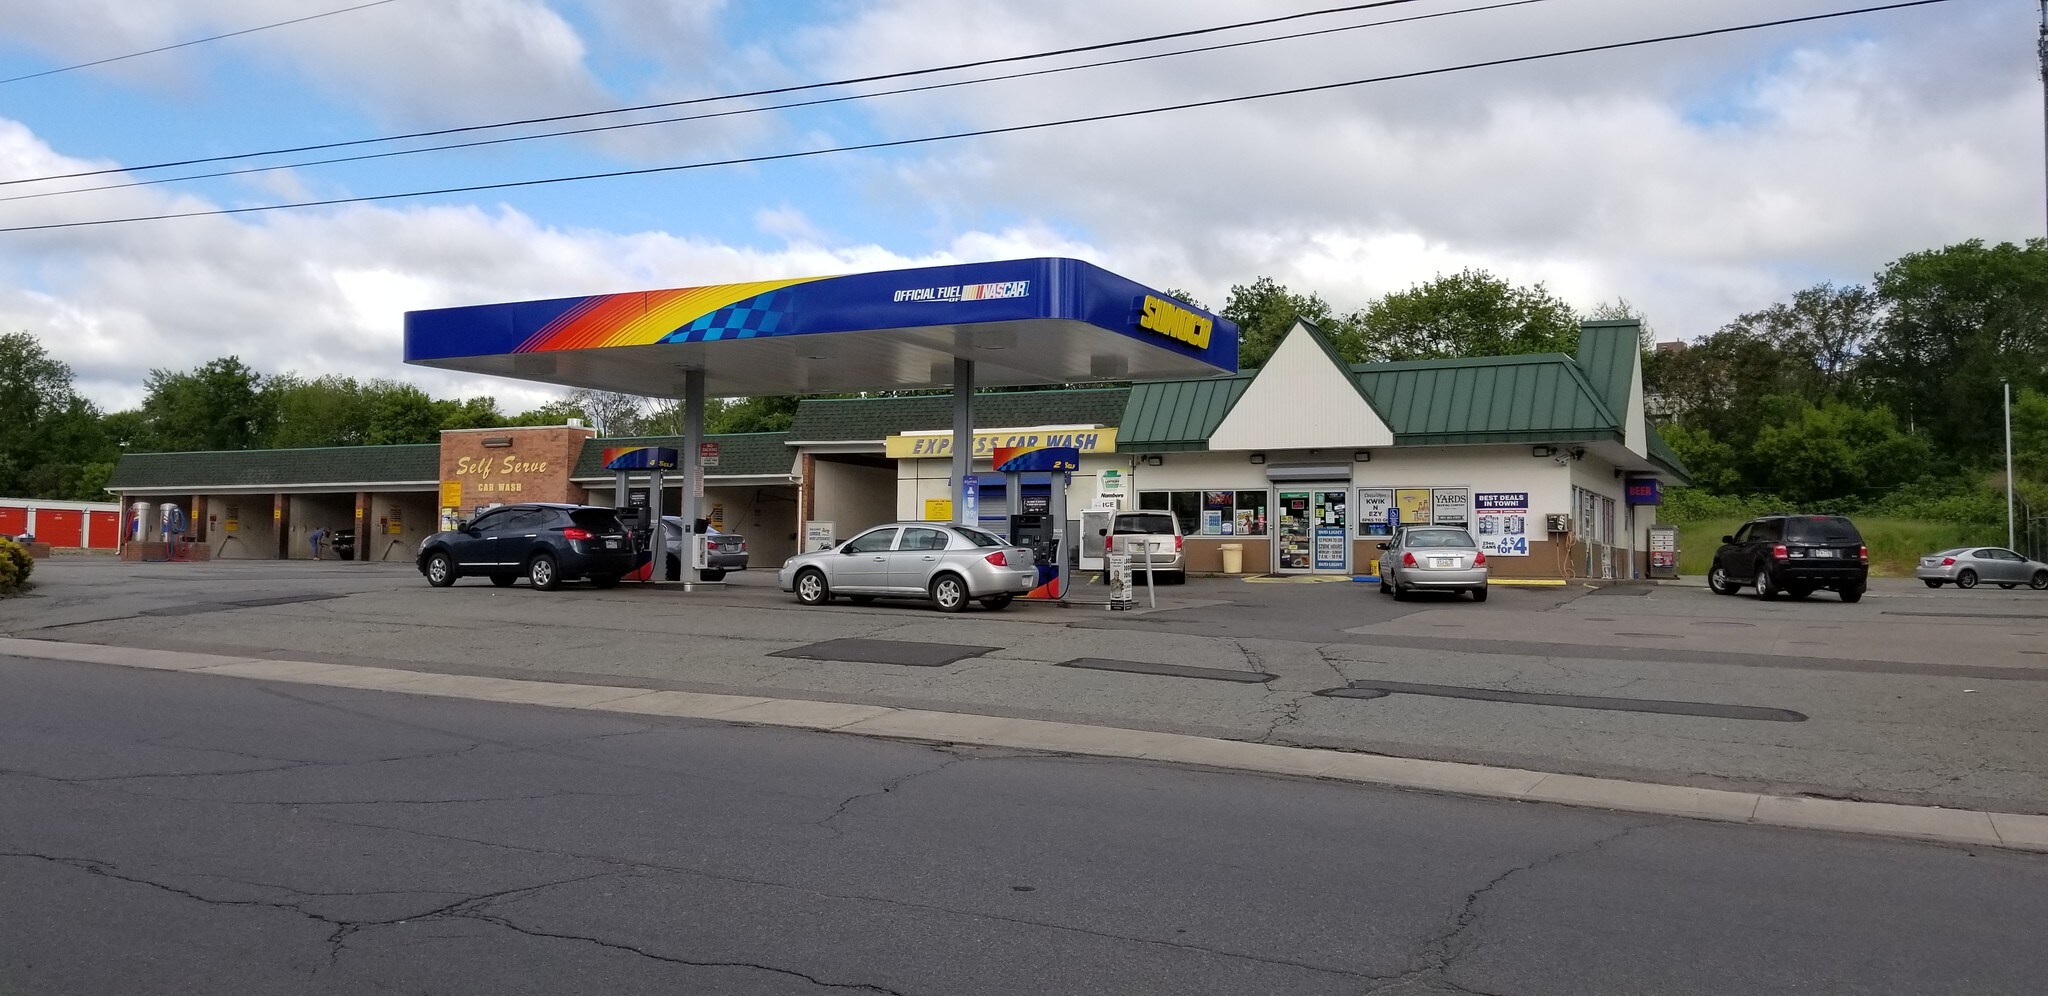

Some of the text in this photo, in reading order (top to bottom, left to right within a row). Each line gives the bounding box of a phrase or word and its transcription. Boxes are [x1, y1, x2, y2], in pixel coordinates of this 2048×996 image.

[893, 286, 961, 302] OFFICIAL FUEL
[982, 282, 1029, 300] NASCAR
[1141, 294, 1213, 349] SUNOCO
[912, 433, 1098, 455] EXPSS CAR WASH
[456, 455, 547, 479] Self Serve
[1053, 461, 1062, 469] 2
[478, 483, 522, 492] CAR WASH
[1629, 486, 1651, 496] BEER
[1435, 494, 1467, 504] YARDS
[1557, 515, 1565, 530] AIR
[1501, 538, 1508, 546] 4
[1497, 544, 1512, 553] for
